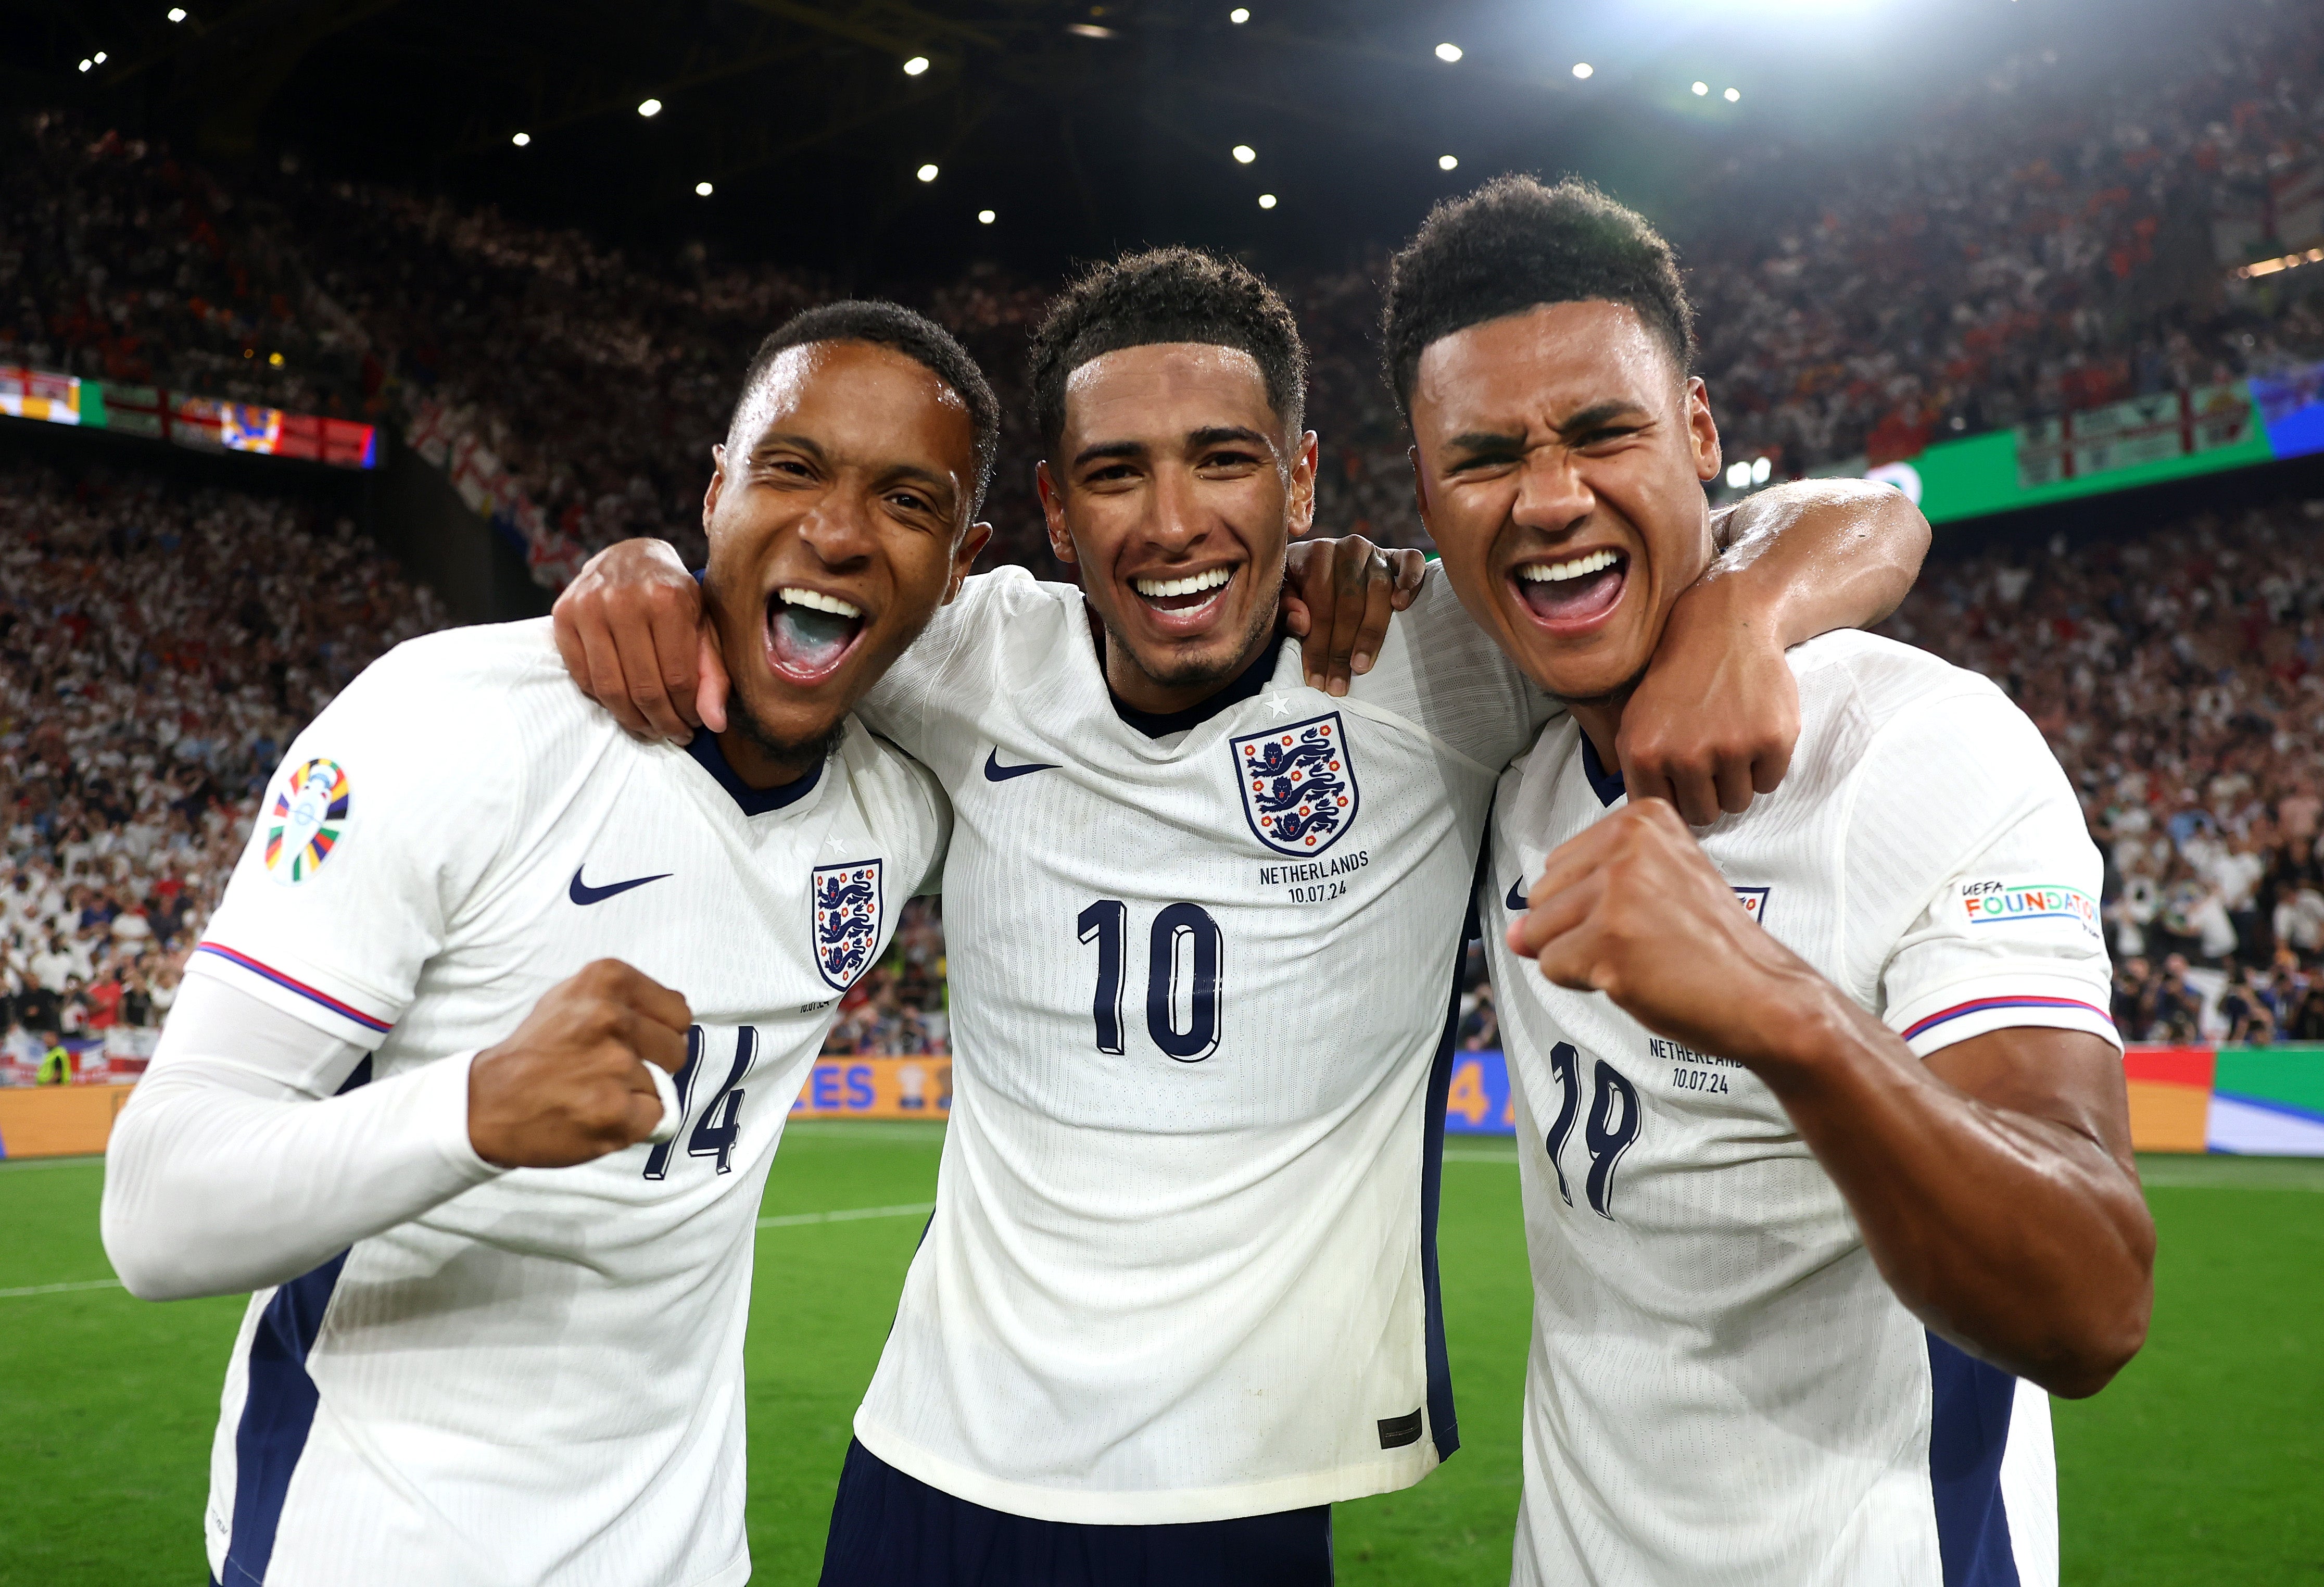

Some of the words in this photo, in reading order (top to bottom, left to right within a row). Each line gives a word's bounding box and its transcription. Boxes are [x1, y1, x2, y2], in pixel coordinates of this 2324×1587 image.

[1259, 851, 1369, 885] NETHERLANDS
[1288, 880, 1347, 903] 10.07.24
[1962, 881, 2003, 896] UEFA
[1078, 900, 1223, 1063] 10
[1673, 1067, 1728, 1094] 10.07.24
[1546, 1041, 1642, 1221] 19
